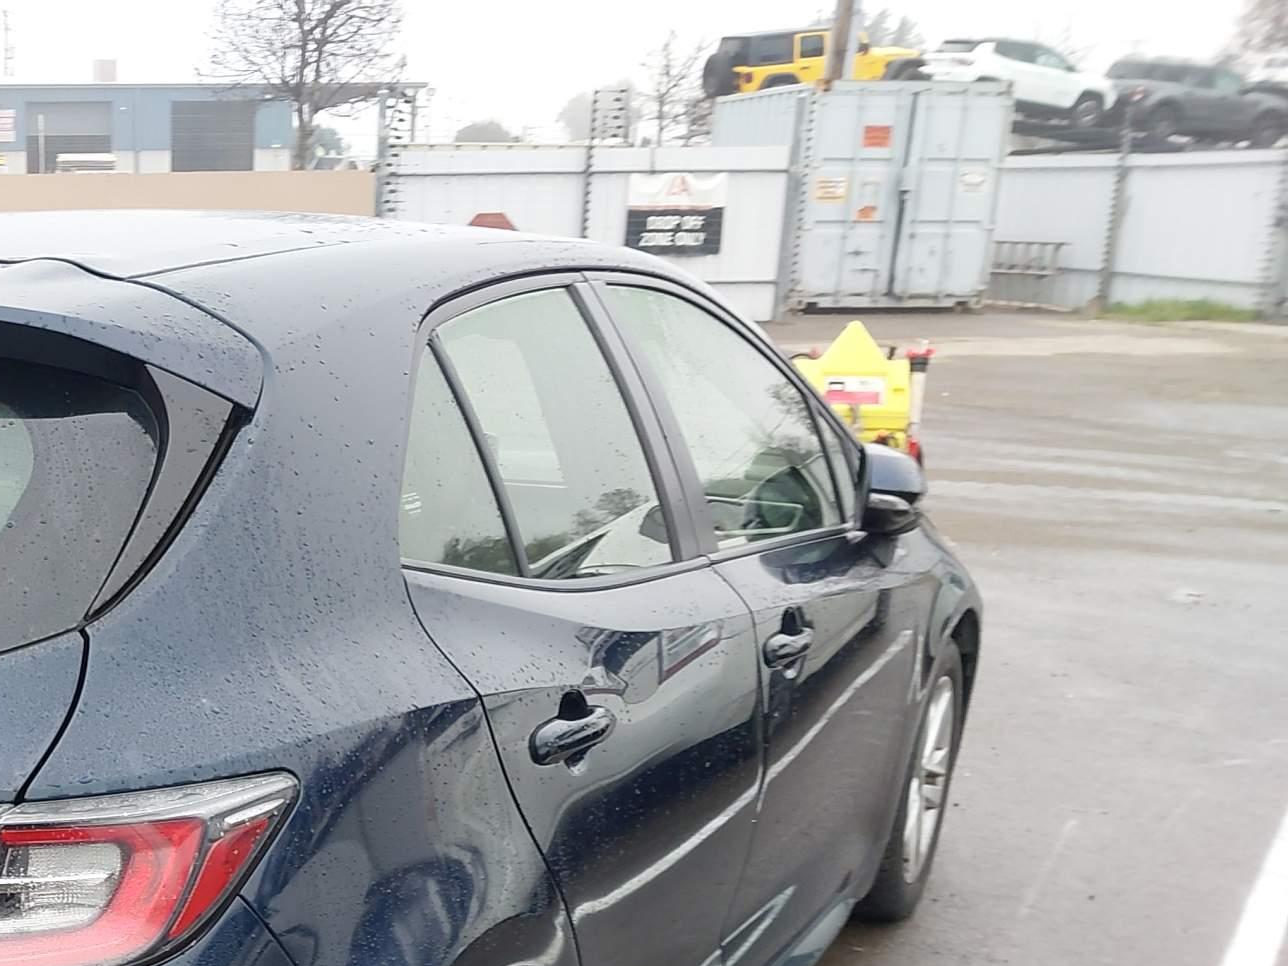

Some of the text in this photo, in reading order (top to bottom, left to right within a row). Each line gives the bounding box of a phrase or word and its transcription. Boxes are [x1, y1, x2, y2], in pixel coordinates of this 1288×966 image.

[646, 215, 707, 230] DROP OFF
[638, 231, 707, 247] ZONE ONLY
